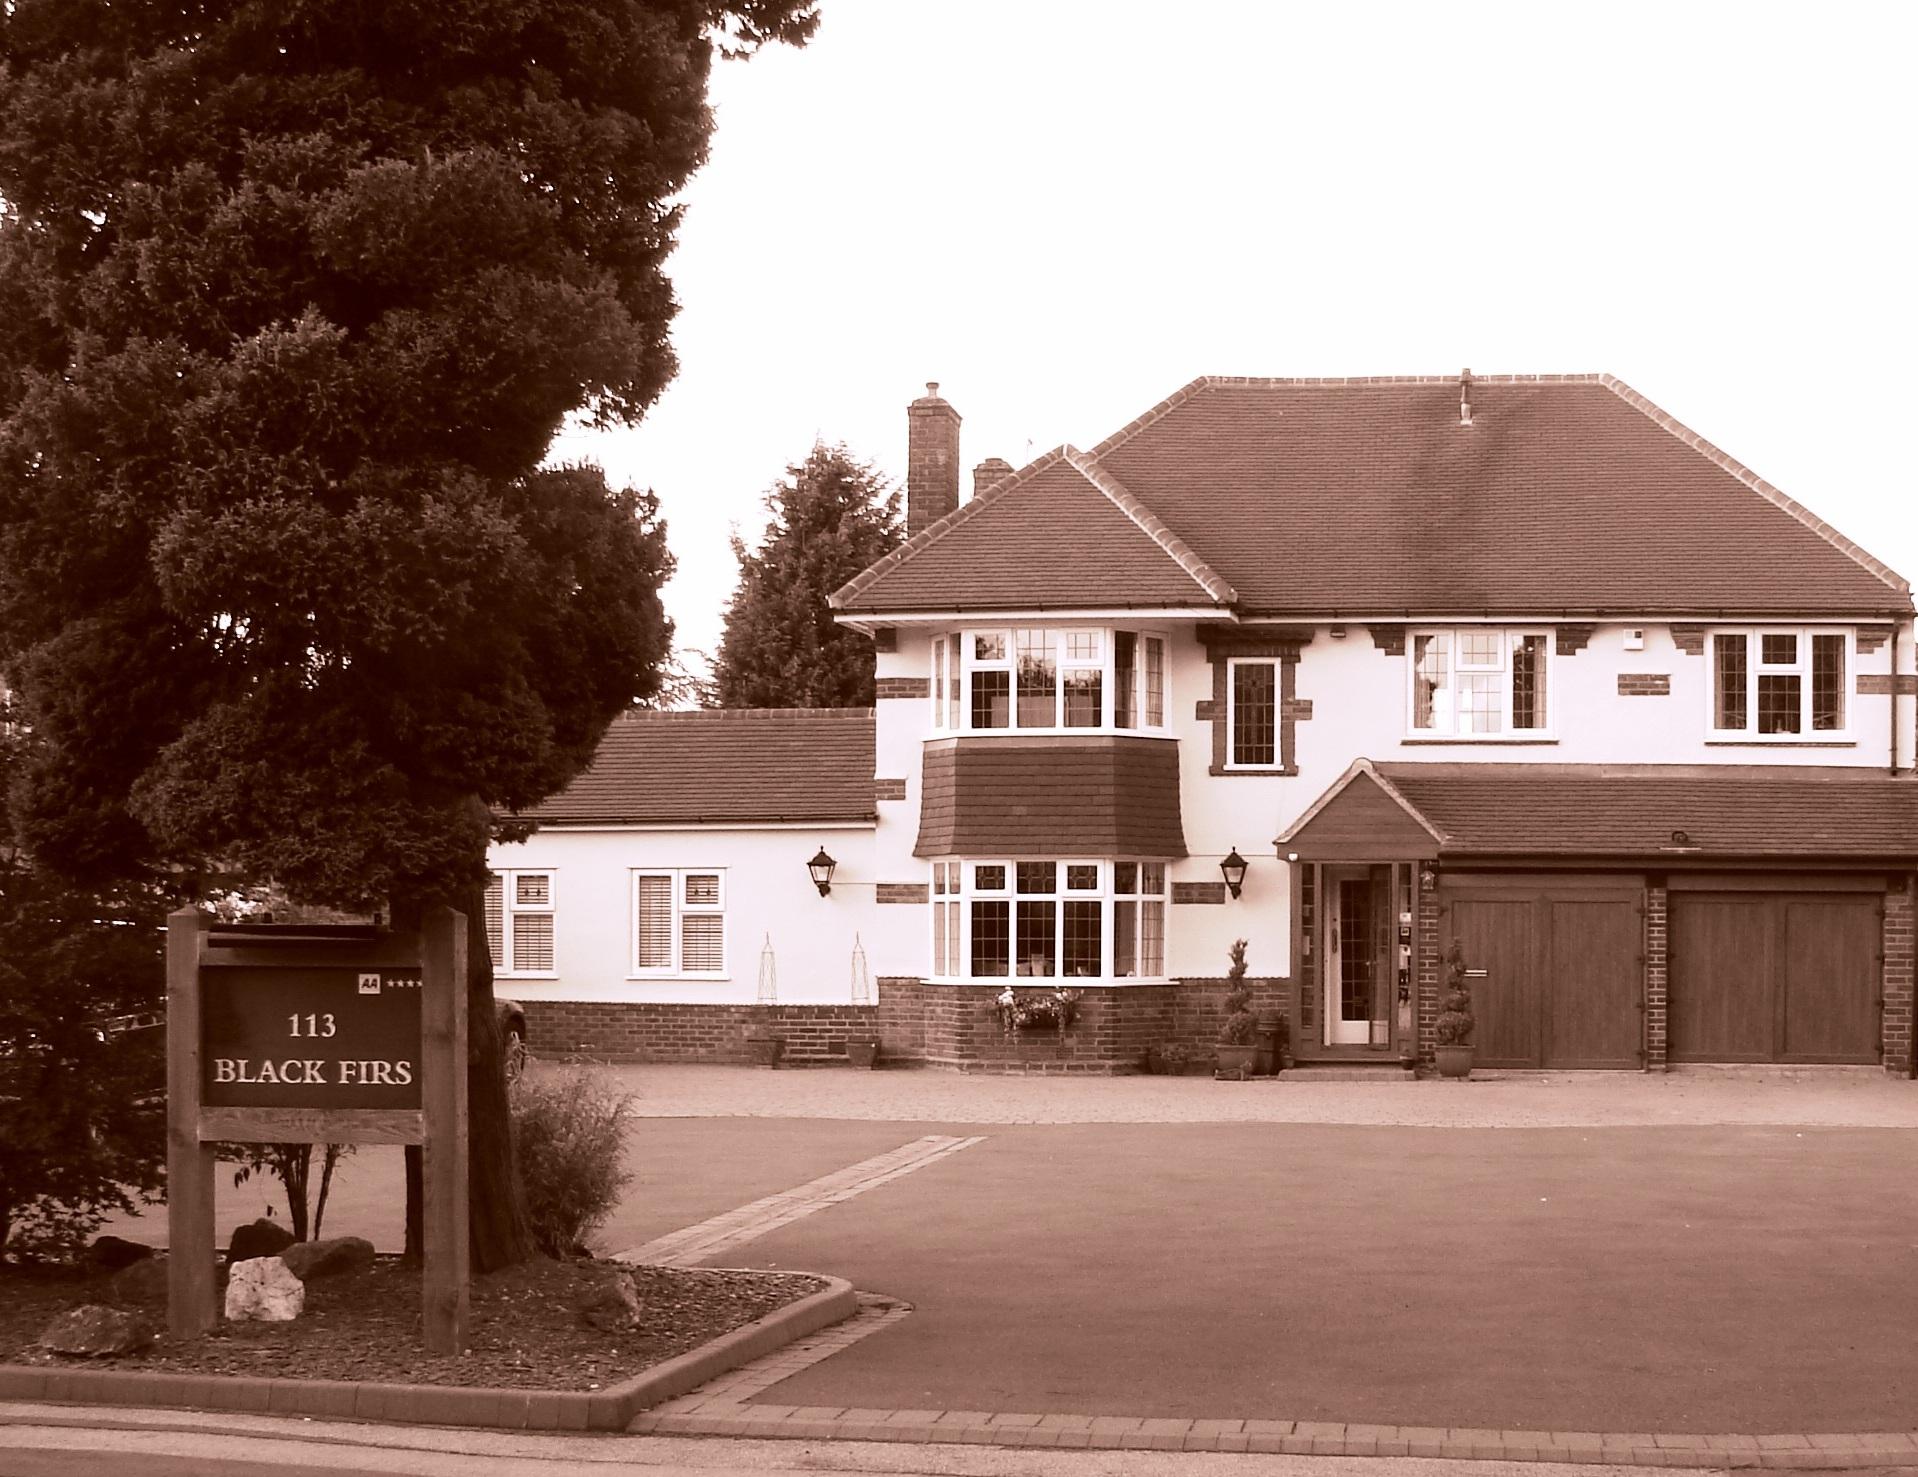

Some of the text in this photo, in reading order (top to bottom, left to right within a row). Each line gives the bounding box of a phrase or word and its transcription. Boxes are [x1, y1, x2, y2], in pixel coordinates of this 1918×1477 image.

[361, 977, 378, 989] AA
[289, 1014, 335, 1037] 113
[215, 1059, 411, 1084] BLACK FIRS
